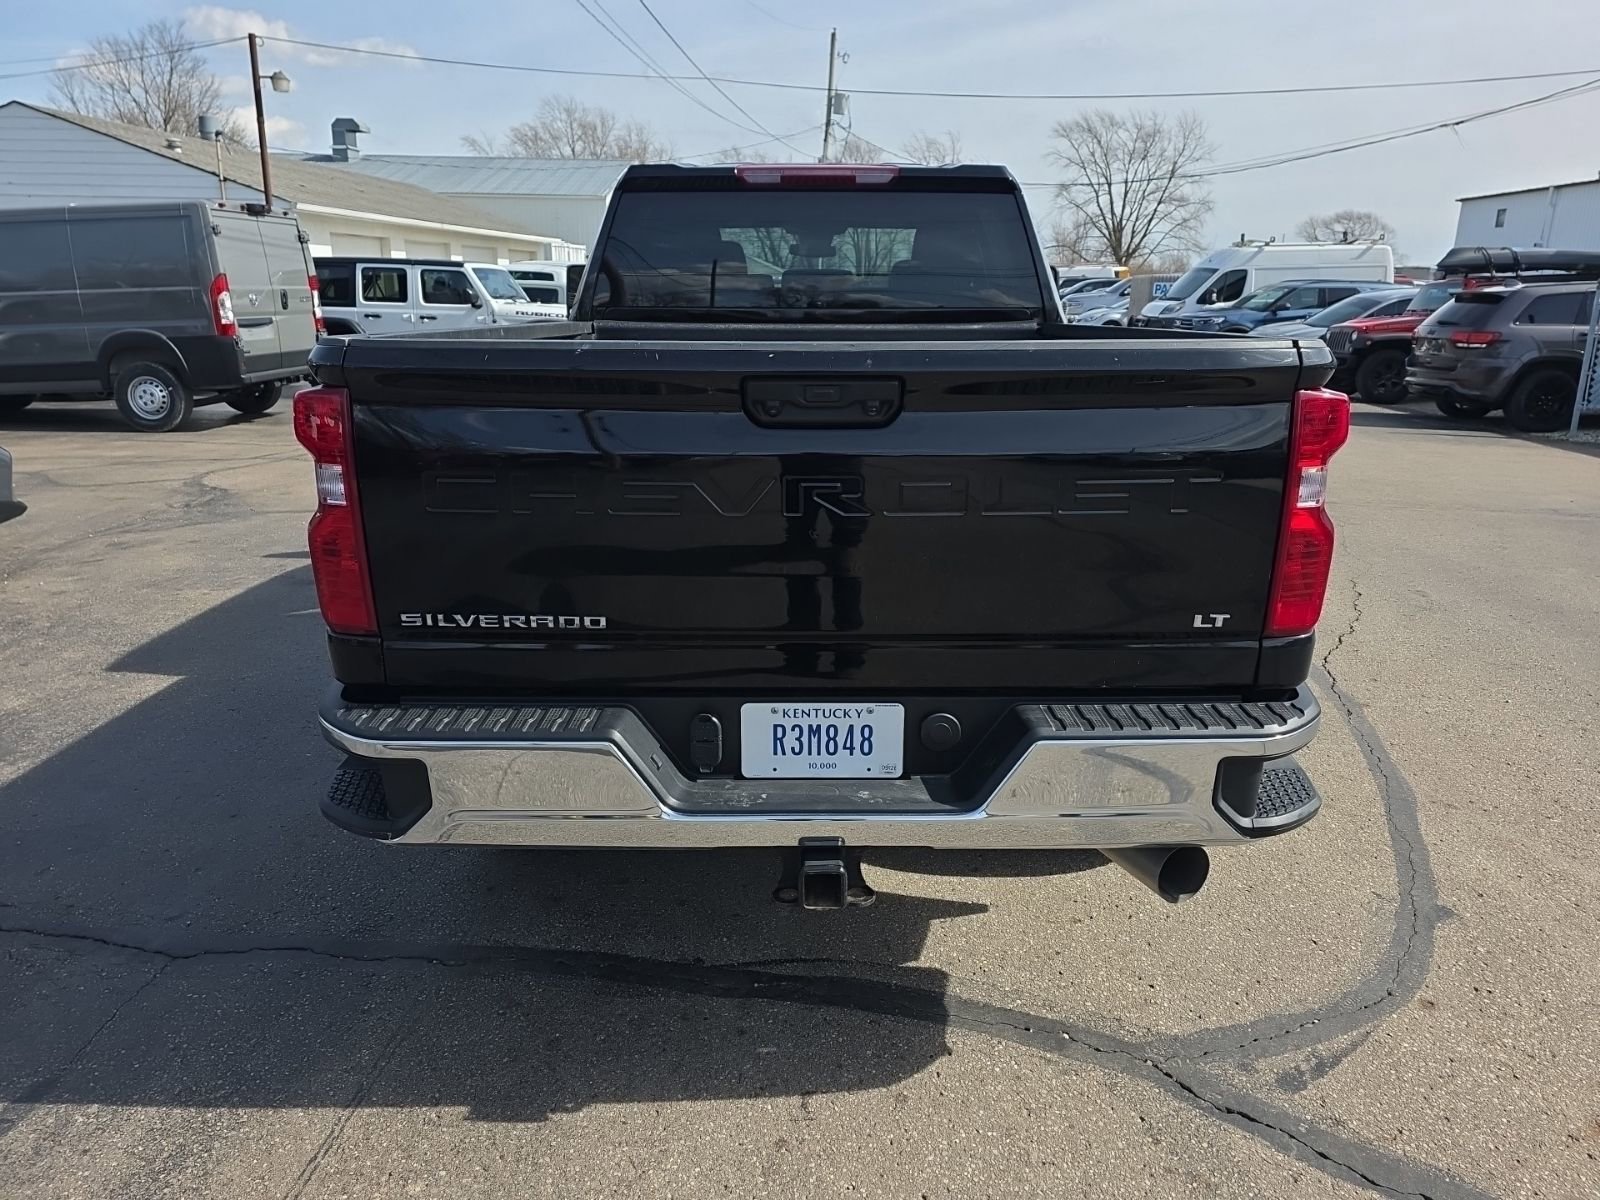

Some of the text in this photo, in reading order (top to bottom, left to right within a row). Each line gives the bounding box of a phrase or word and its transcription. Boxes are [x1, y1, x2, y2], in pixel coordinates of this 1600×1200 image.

[1154, 283, 1174, 295] PA
[515, 310, 568, 319] RUBICO
[423, 471, 1224, 517] CHEVROLET
[400, 613, 607, 630] SILVERADO
[1192, 614, 1231, 628] LT
[782, 708, 864, 719] KENTUCKY
[772, 723, 874, 757] R3M848
[808, 762, 837, 770] 10,000
